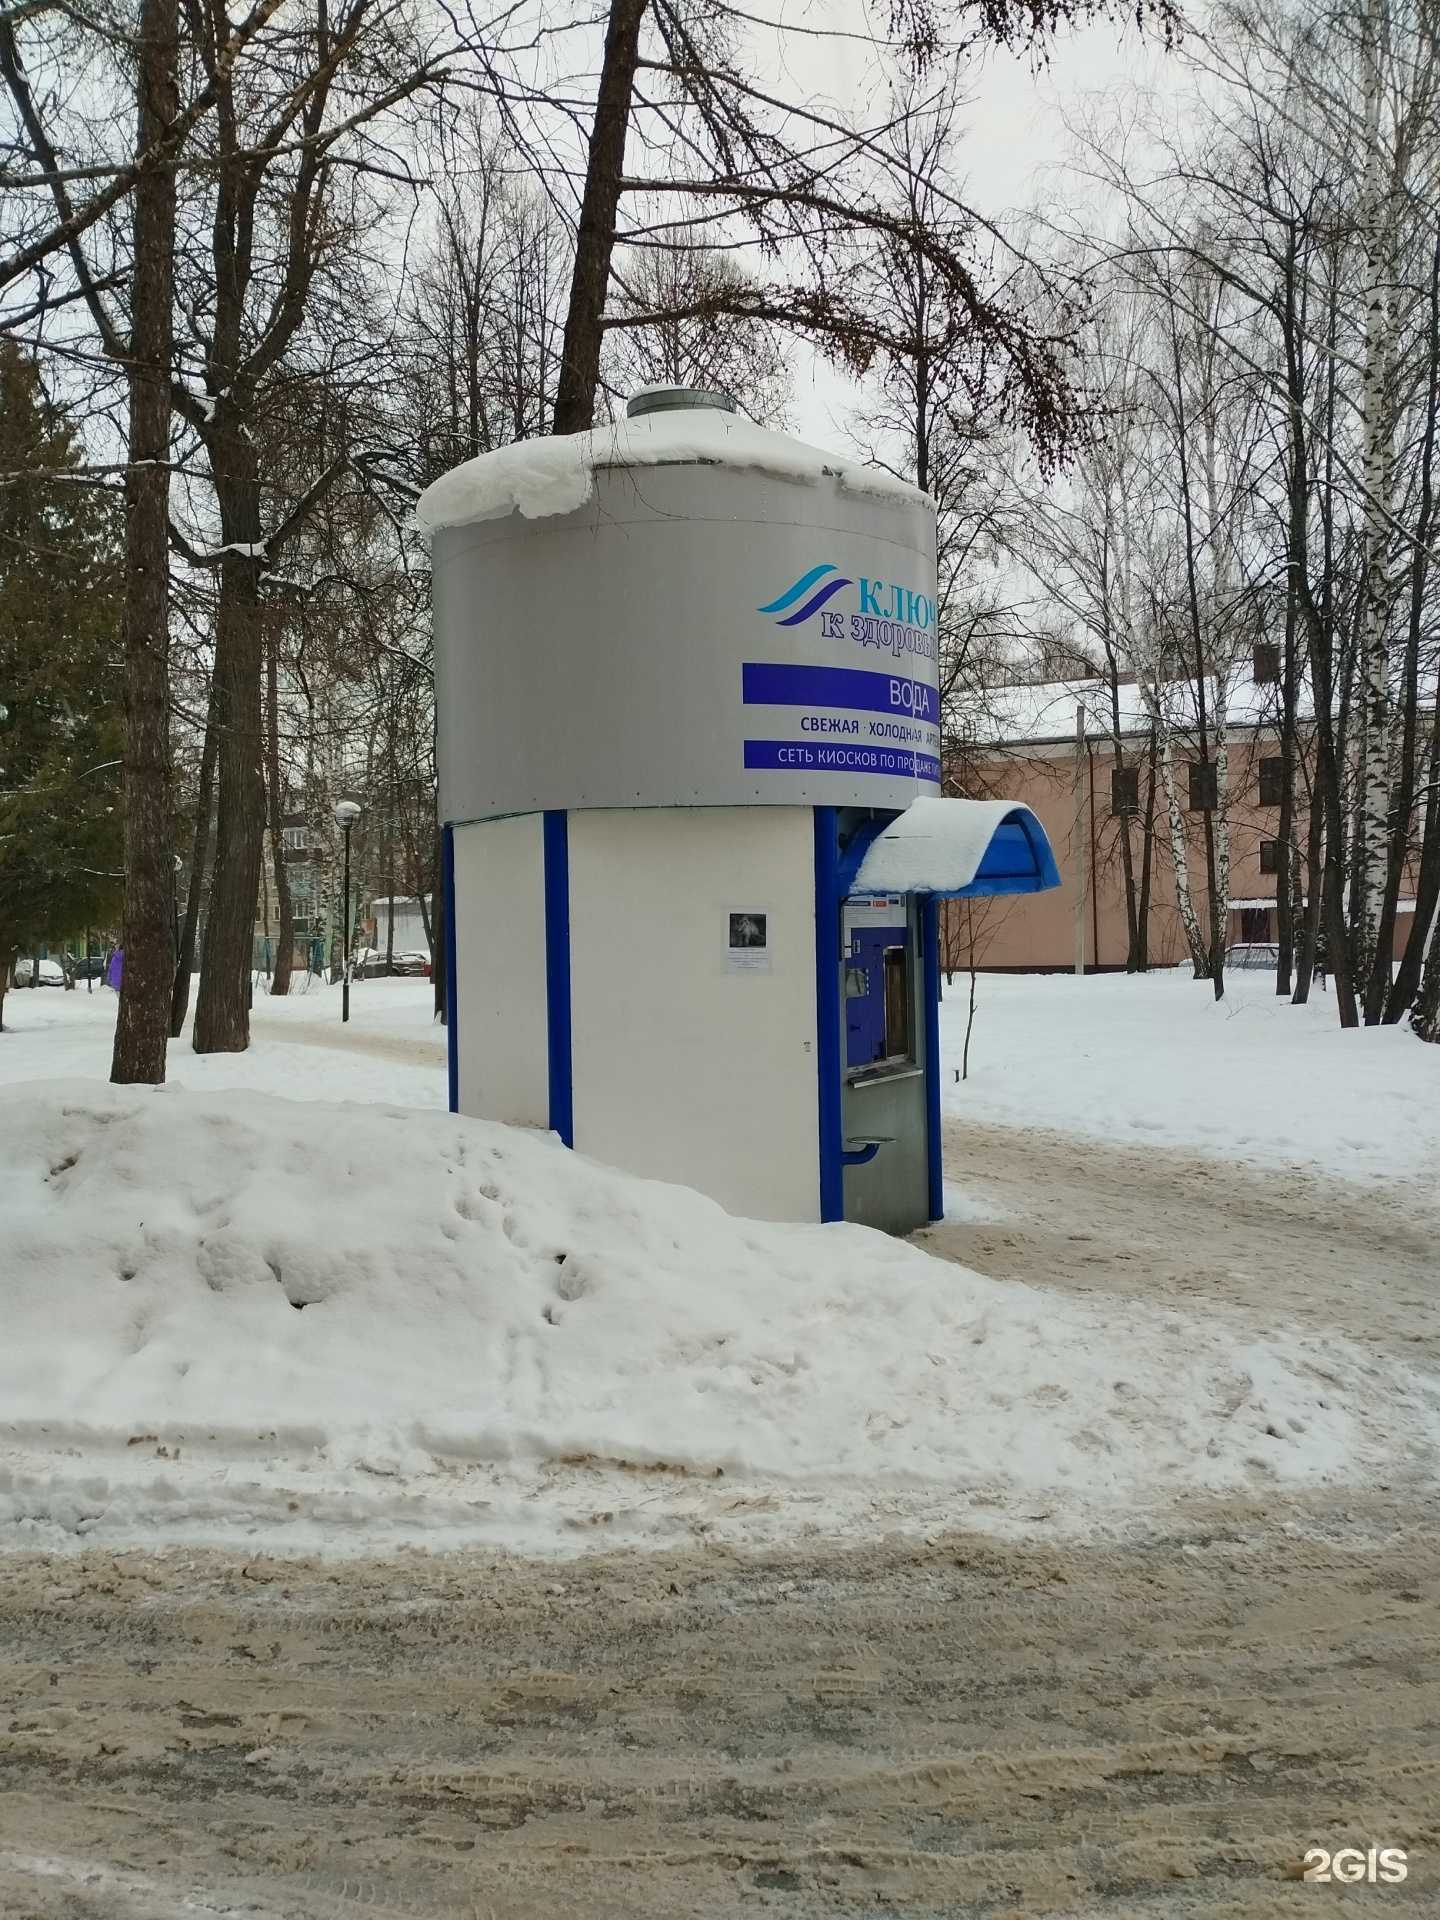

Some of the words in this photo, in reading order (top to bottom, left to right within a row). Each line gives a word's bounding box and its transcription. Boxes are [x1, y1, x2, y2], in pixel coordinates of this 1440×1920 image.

[889, 679, 930, 717] ВОДА
[800, 716, 859, 735] СВЕЖАЯ
[869, 721, 922, 743] ХОЛОДНАЯ
[778, 748, 814, 764] СЕТЬ
[818, 749, 878, 768] КИОСКОВ
[880, 753, 895, 768] ПО
